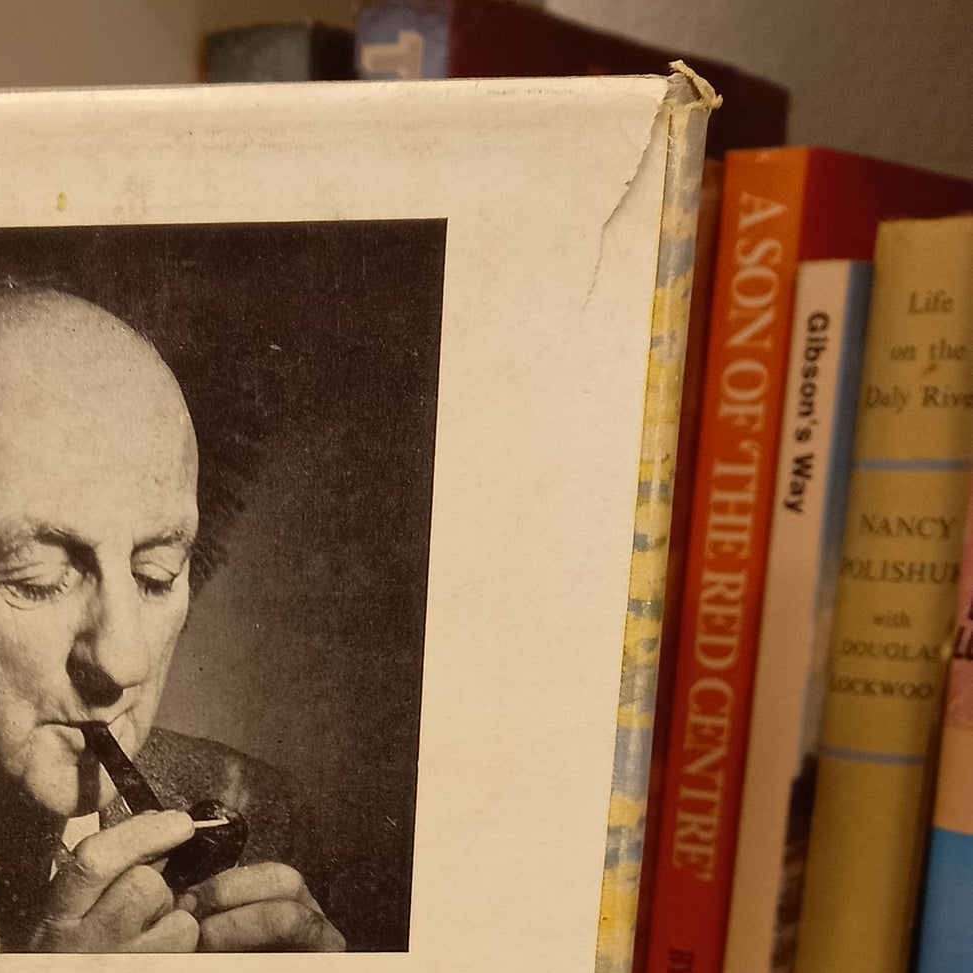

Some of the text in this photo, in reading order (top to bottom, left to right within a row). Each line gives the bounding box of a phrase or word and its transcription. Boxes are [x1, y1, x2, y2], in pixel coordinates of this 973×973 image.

[738, 191, 788, 230] A
[726, 237, 784, 350] SON
[908, 289, 954, 314] Life
[890, 338, 967, 361] on the
[719, 359, 770, 433] OF
[783, 311, 831, 514] Gibson's Way
[860, 513, 956, 539] NANCY
[693, 570, 748, 671] RED
[872, 608, 912, 629] with
